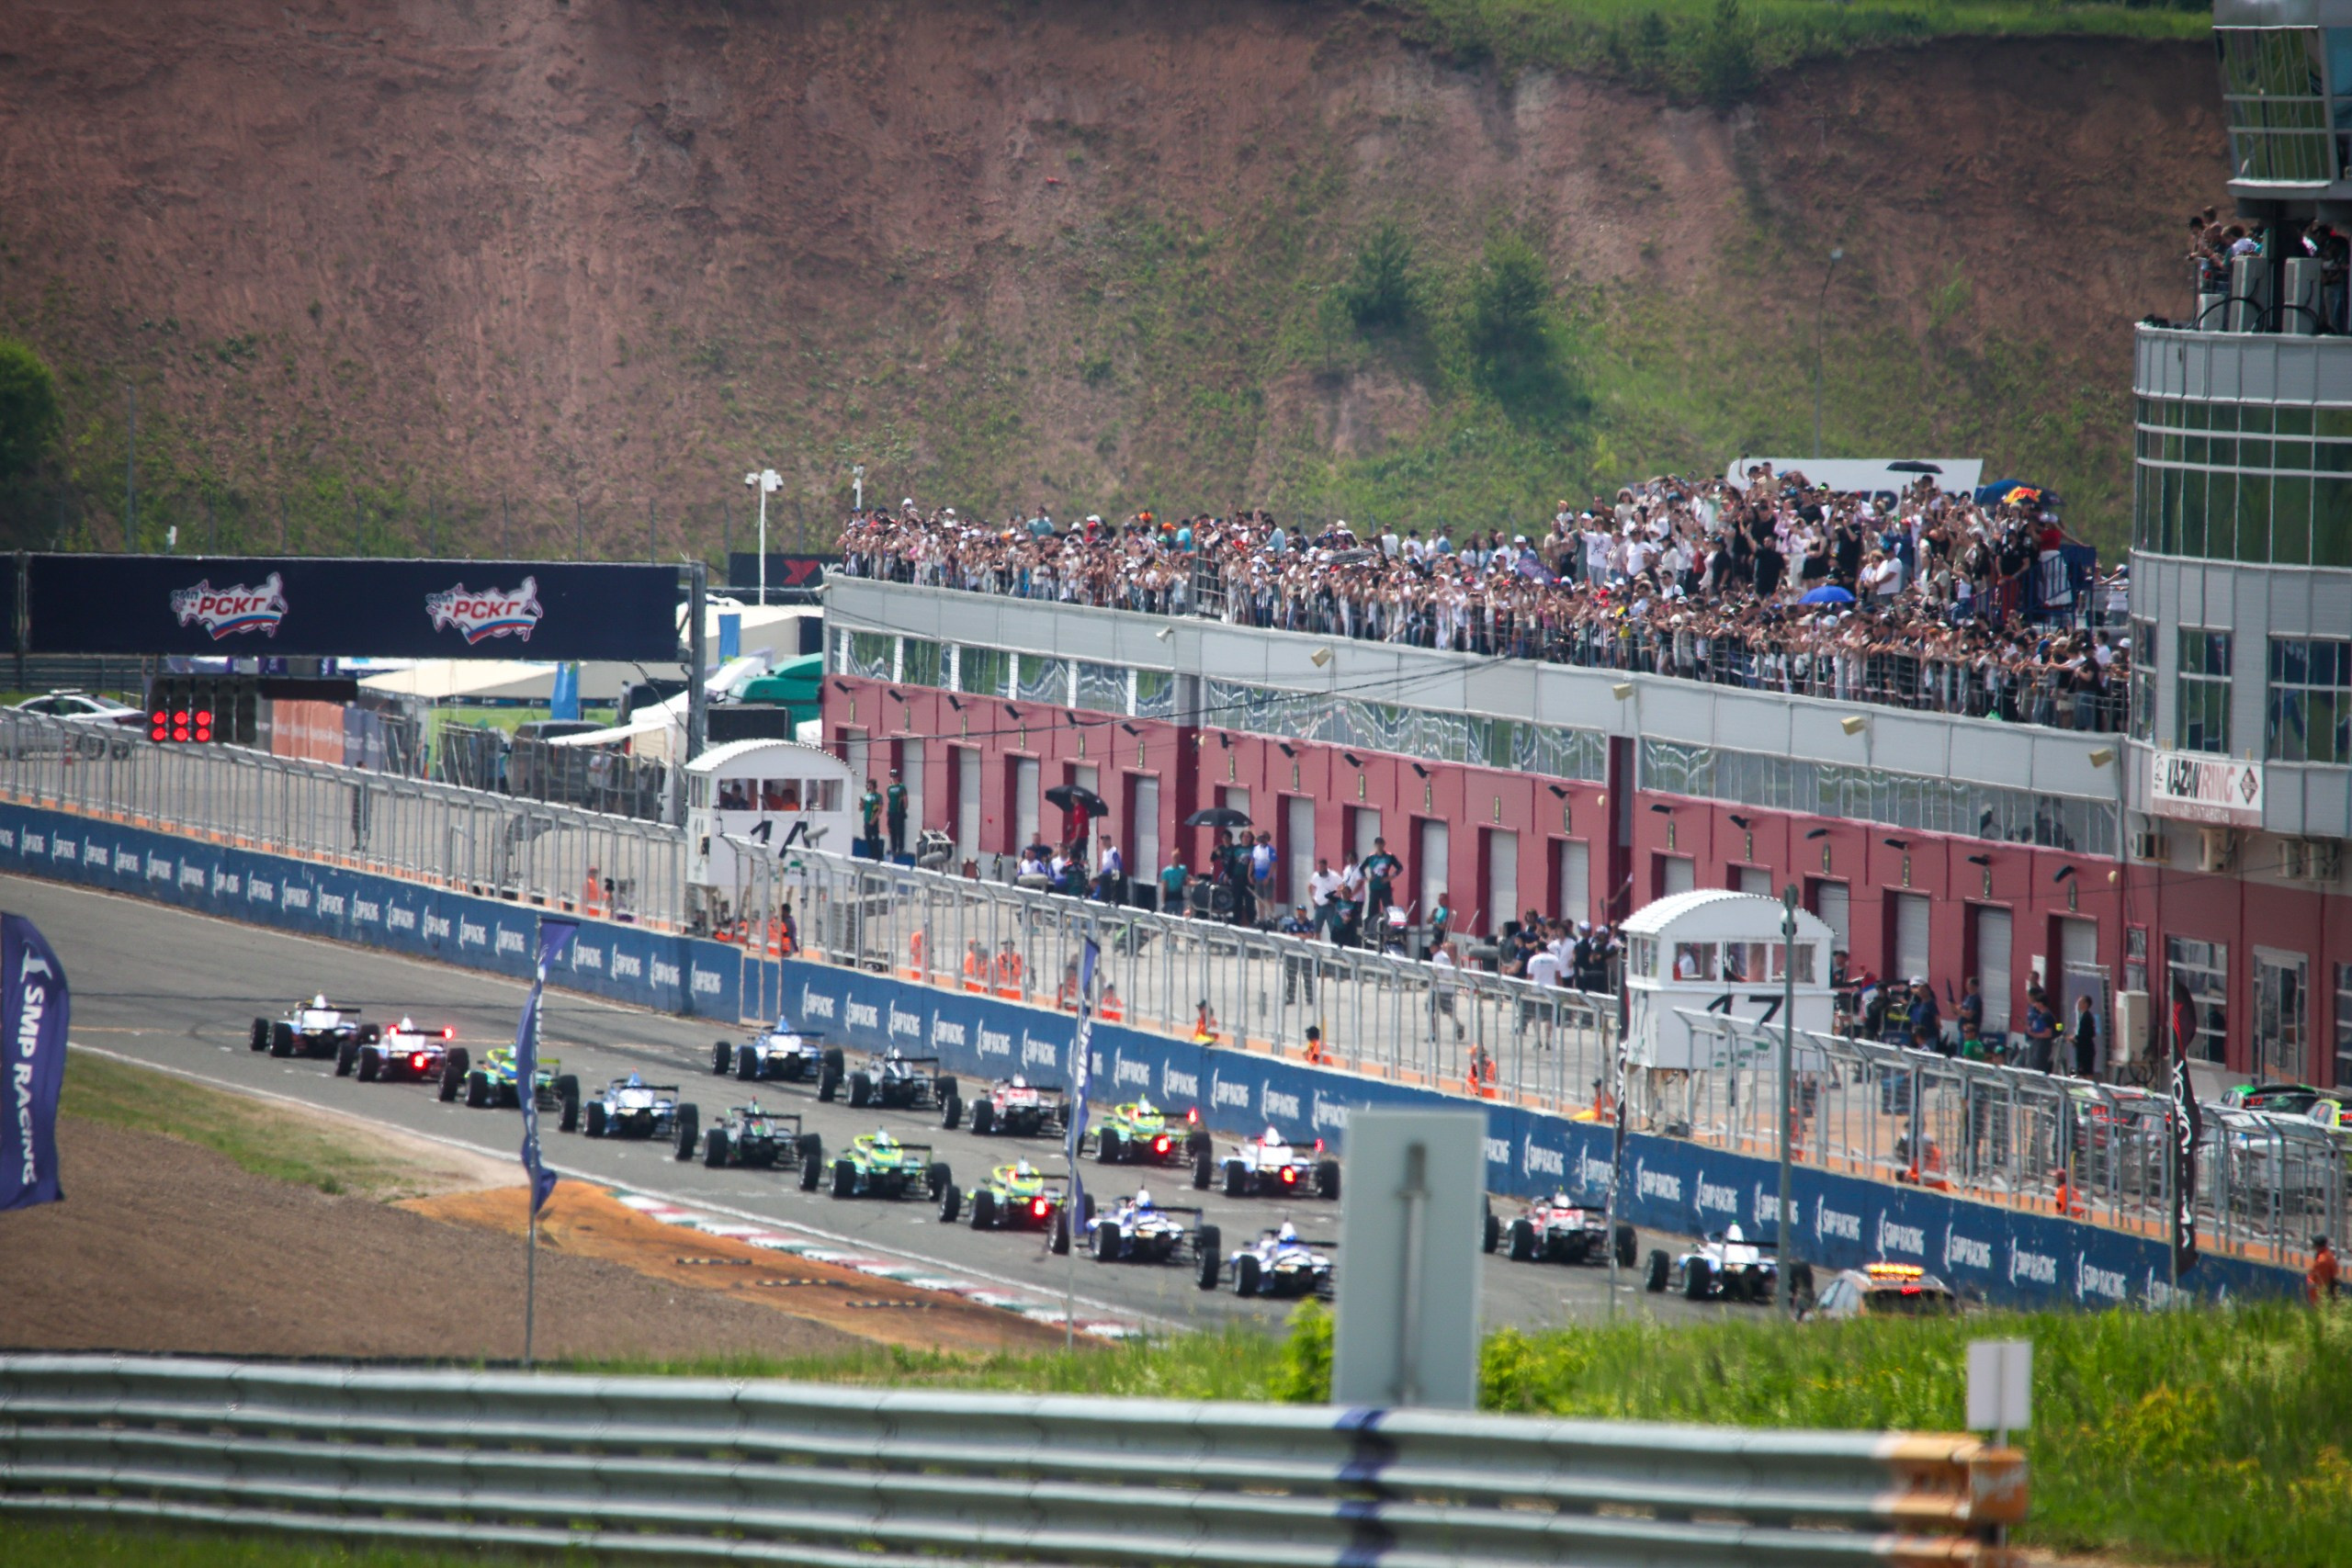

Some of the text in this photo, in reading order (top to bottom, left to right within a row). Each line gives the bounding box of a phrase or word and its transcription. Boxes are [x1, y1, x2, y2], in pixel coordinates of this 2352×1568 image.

[198, 597, 266, 615] РСКГ
[453, 601, 521, 619] РСКГ
[13, 985, 44, 1186] SMP RACING
